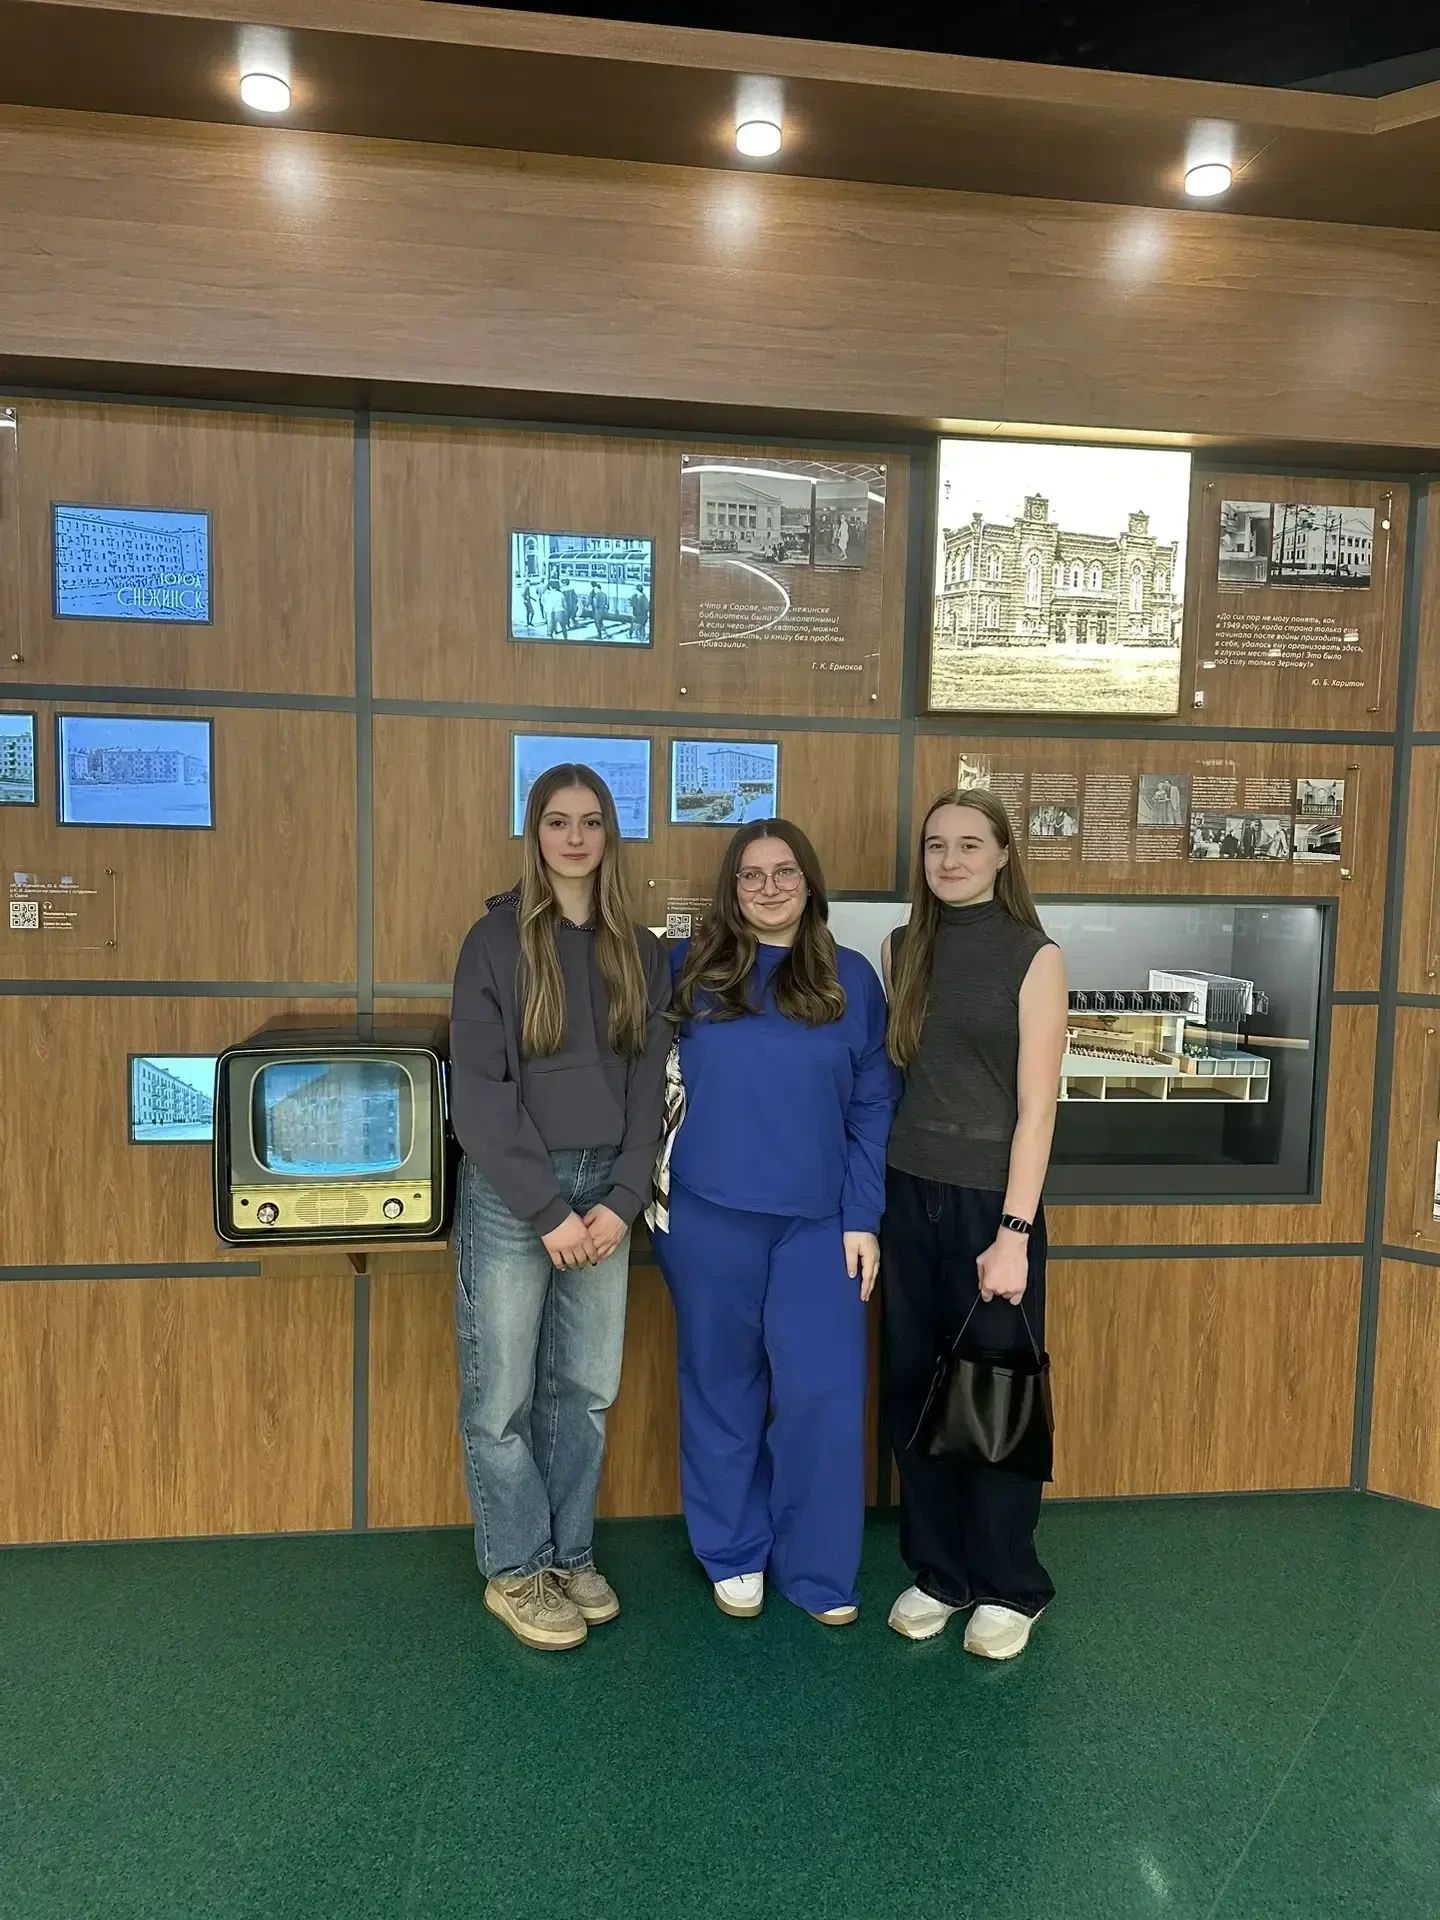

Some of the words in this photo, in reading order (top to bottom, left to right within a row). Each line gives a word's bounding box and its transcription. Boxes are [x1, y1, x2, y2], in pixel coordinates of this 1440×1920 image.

[160, 572, 202, 588] ГОРОД
[118, 586, 203, 609] СНЕЖИНСК
[730, 602, 760, 612] Сарове,
[699, 611, 749, 620] библиотеки
[774, 625, 811, 633] хватало,
[1241, 623, 1260, 631] году,
[698, 630, 720, 638] было
[810, 634, 845, 643] проблем
[1342, 644, 1364, 653] здесь,
[830, 662, 863, 672] Ермаков
[1277, 660, 1314, 669] Зернову!»
